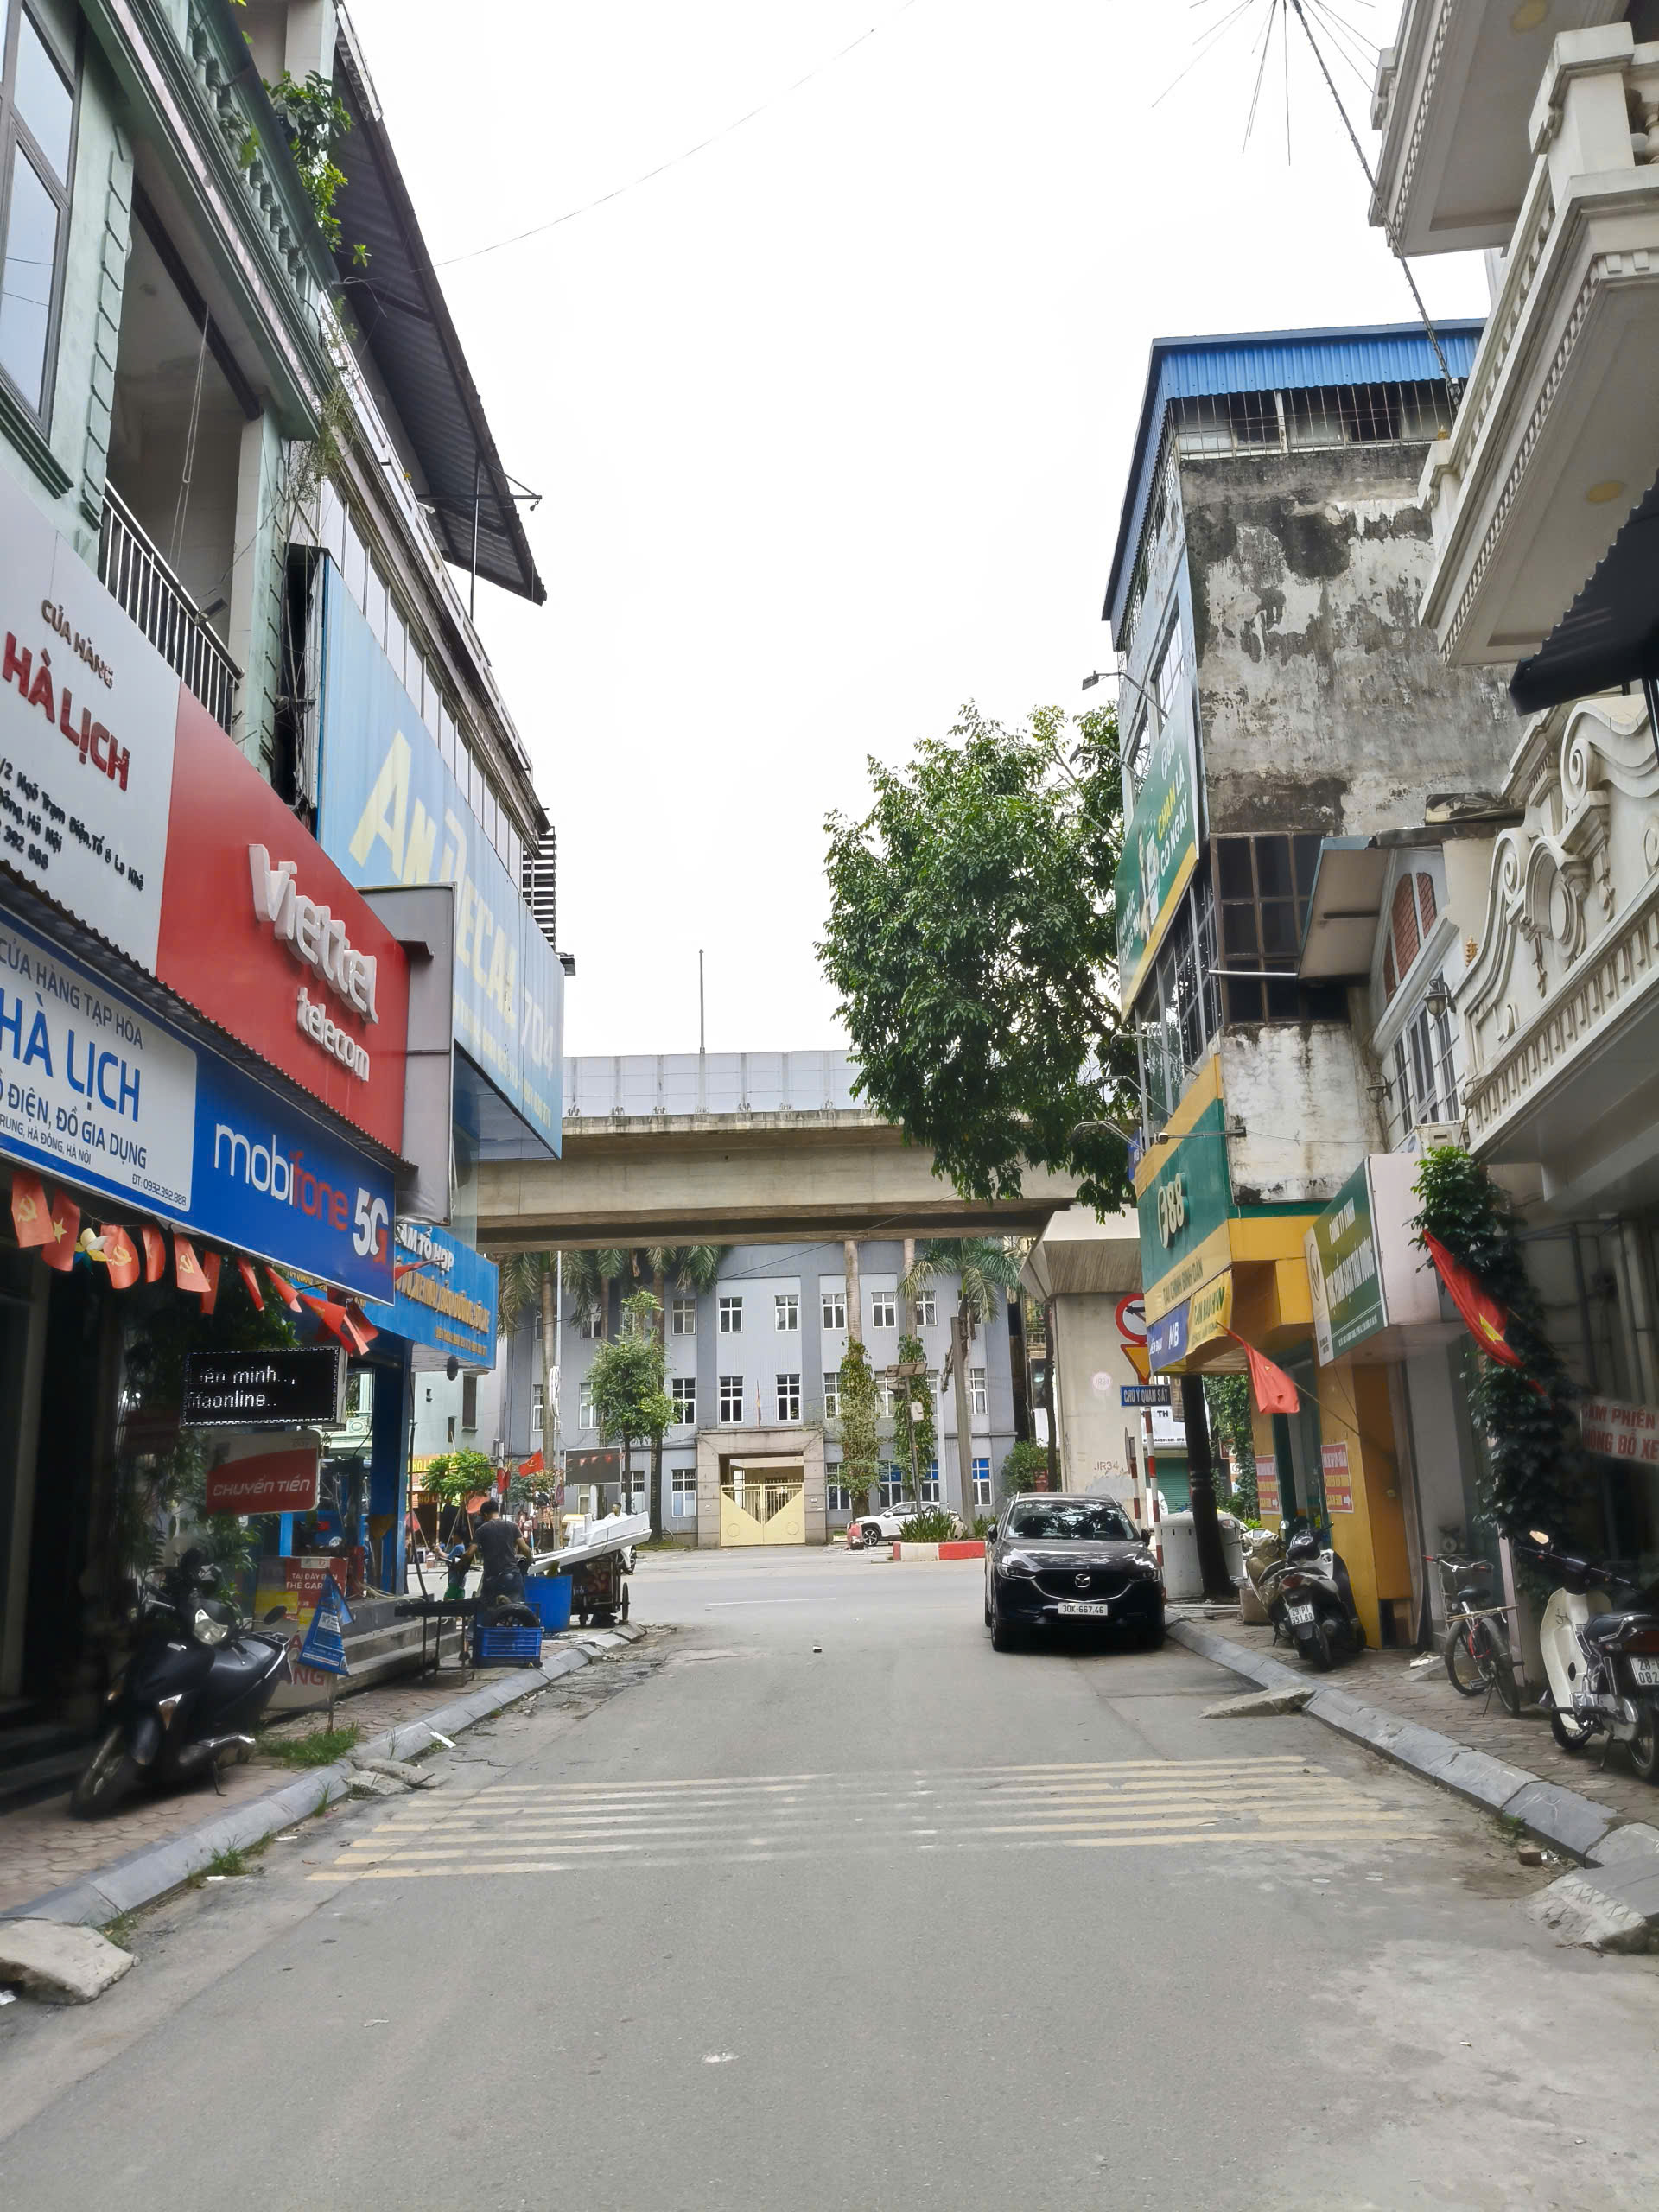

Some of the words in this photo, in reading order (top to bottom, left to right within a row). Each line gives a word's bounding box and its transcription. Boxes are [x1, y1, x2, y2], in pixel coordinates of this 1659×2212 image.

[74, 632, 114, 690] HÀNG
[3, 631, 55, 724] HÀ
[60, 687, 130, 791] LỊCH
[1170, 792, 1188, 855] NGAY
[248, 843, 379, 1025] Viettel
[35, 963, 80, 1010] HÀNG
[84, 993, 112, 1027] TẠP
[116, 1014, 143, 1051] HÓA
[296, 986, 370, 1083] telecom
[0, 986, 54, 1078] HÀ
[67, 1028, 141, 1123] LỊCH
[7, 1082, 52, 1130] ĐIỆN,
[56, 1105, 79, 1138] ĐỒ
[81, 1120, 106, 1153] GIA
[109, 1132, 147, 1171] DỤNG
[27, 1126, 39, 1142] HÀ
[40, 1132, 65, 1155] ĐÔNG,
[66, 1143, 77, 1160] HÀ
[78, 1149, 92, 1166] NỘI
[213, 1123, 350, 1232] mobifone
[353, 1187, 389, 1265] 5G
[1168, 1321, 1179, 1350] MB
[1123, 1387, 1135, 1403] CHÚ
[1141, 1389, 1157, 1404] QUAN
[1157, 1386, 1168, 1402] SÁT
[1062, 1605, 1104, 1614] 30K-667.46
